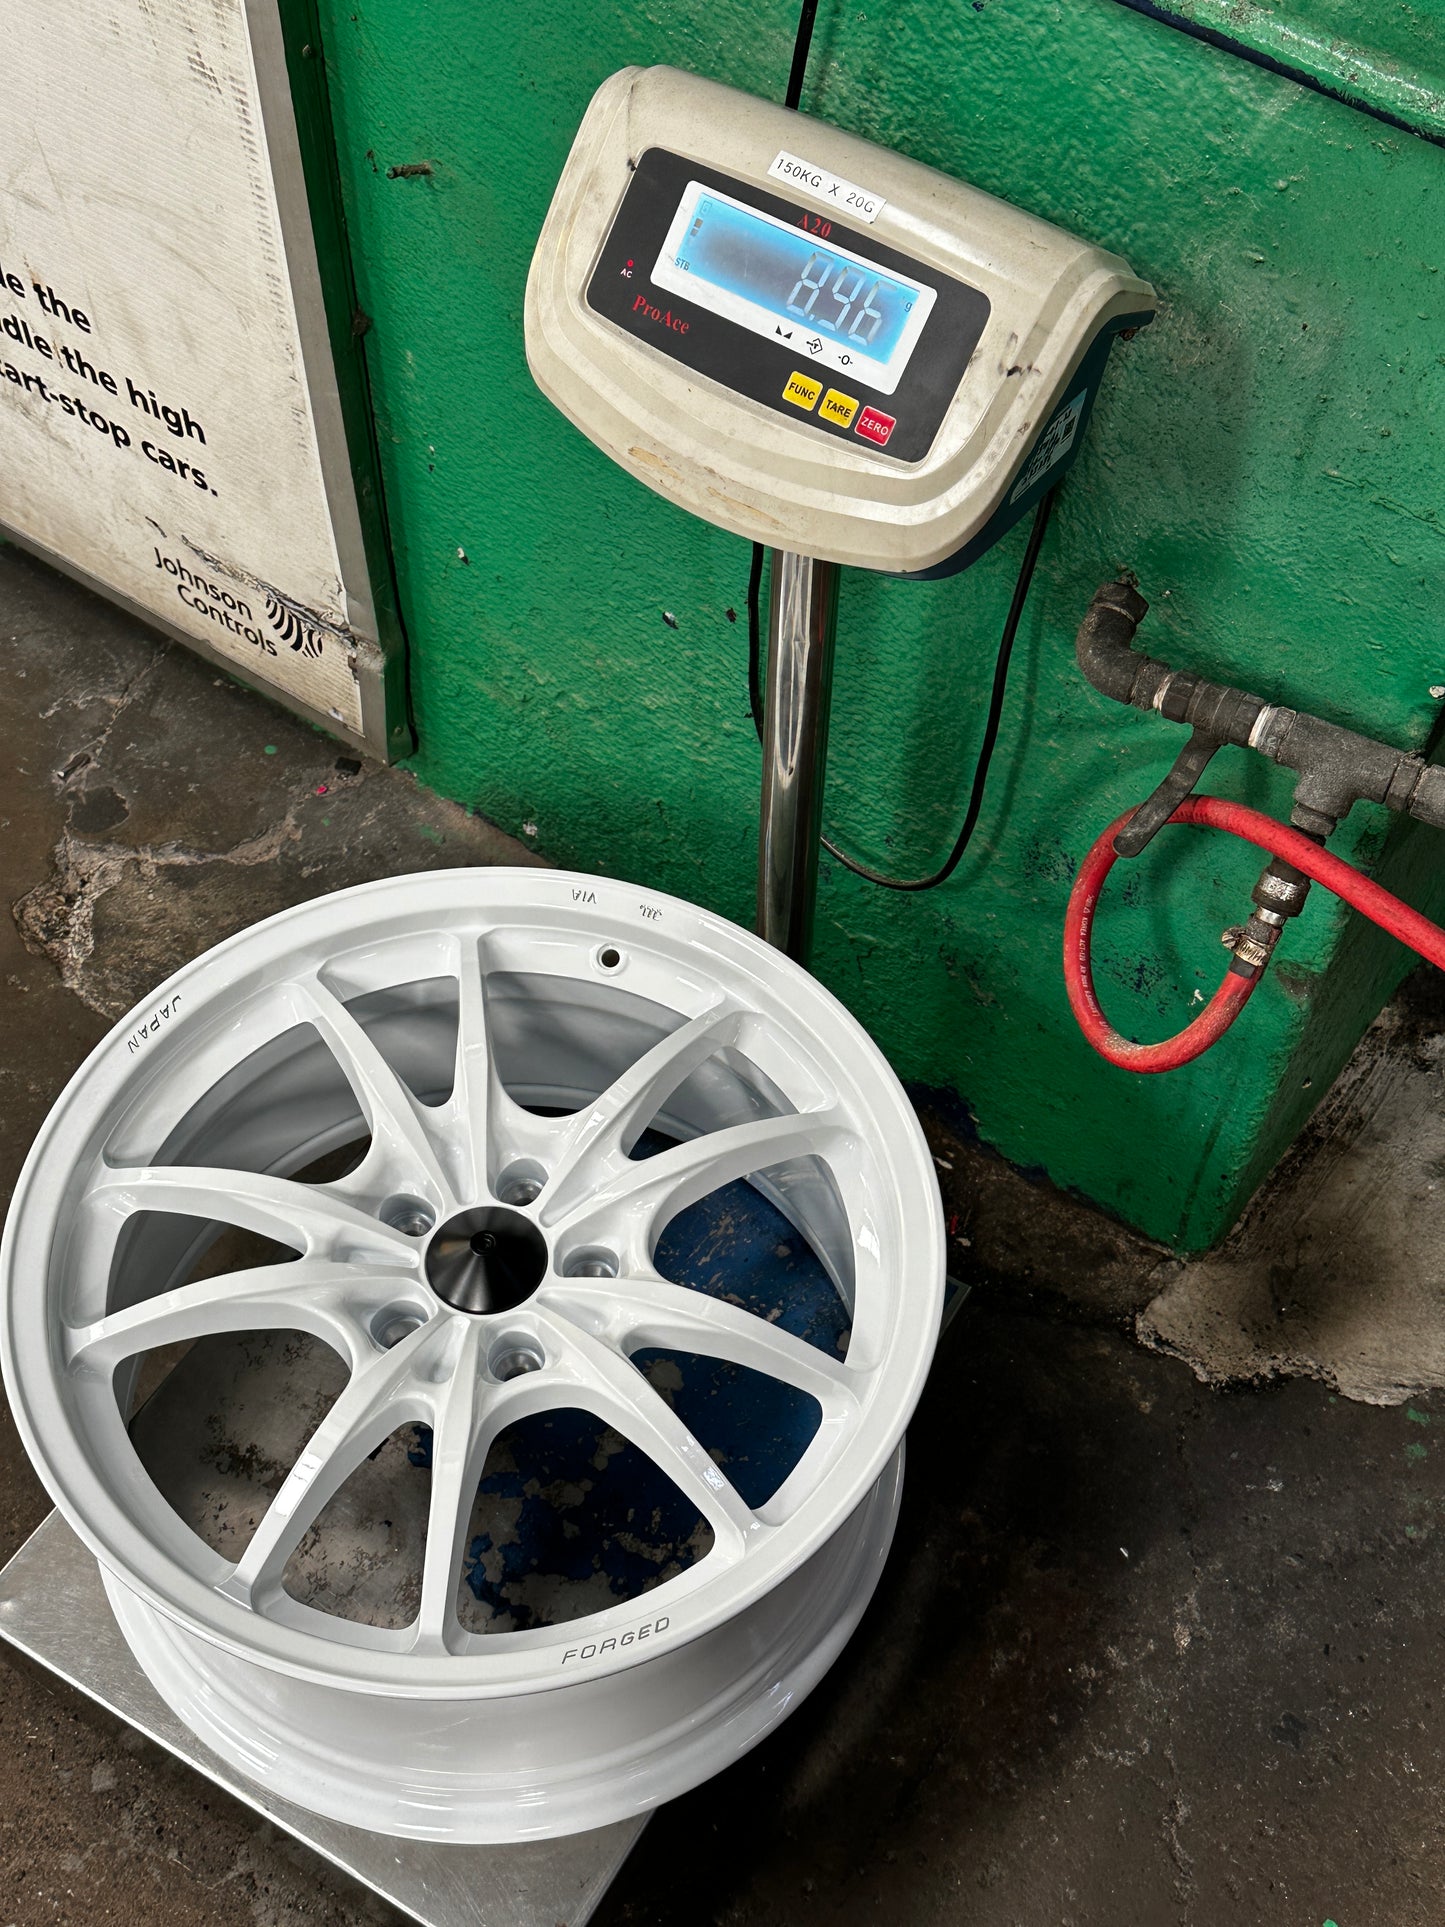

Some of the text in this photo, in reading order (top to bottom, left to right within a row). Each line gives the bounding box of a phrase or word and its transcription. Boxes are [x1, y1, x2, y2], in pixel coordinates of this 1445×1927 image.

[777, 158, 876, 214] 150KG X 20G
[796, 213, 831, 238] A20
[620, 268, 633, 279] AC
[674, 257, 691, 272] STB
[33, 283, 91, 334] the
[632, 294, 690, 334] ProAce
[0, 313, 206, 445] dle the high
[788, 382, 816, 400] FUNC
[826, 400, 852, 418] TARE
[861, 417, 889, 436] ZERO
[142, 439, 219, 497] cars.
[154, 547, 253, 621] Johnson
[178, 584, 278, 657] Controls
[571, 888, 597, 904] VIA
[127, 994, 181, 1054] JAPAN
[561, 1616, 670, 1665] FORGED
